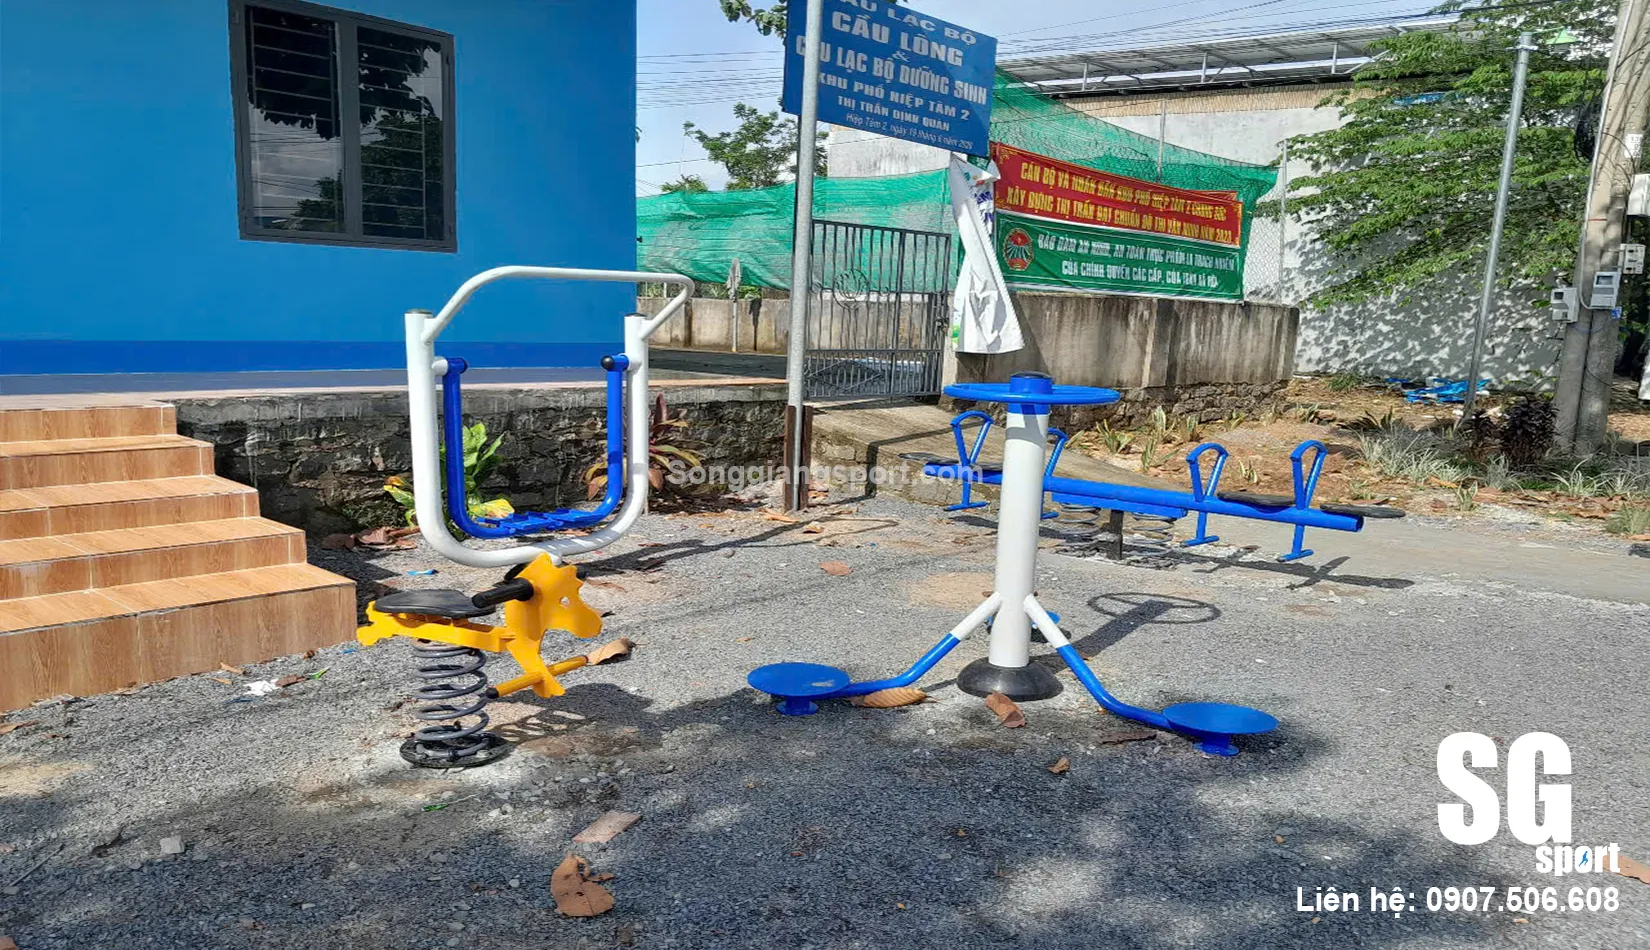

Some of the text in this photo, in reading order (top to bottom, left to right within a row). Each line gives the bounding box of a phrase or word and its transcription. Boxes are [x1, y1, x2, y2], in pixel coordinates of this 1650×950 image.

[832, 11, 964, 67] CẦU LÔNG
[887, 8, 936, 32] LẠC
[944, 27, 977, 46] BỘ
[796, 34, 988, 105] CU LẠC BỘ DƯỠNG SINH
[892, 50, 910, 63] &
[837, 95, 856, 111] THỊ
[860, 101, 889, 117] TRẤN
[853, 83, 885, 99] PHỐ
[929, 101, 956, 118] TÂM
[960, 110, 970, 121] 2
[1021, 161, 1041, 183] CÁN
[1042, 167, 1056, 189] BỘ
[1006, 185, 1026, 206] XÂY
[1056, 197, 1071, 219] THỊ
[1061, 257, 1078, 276] CỦA
